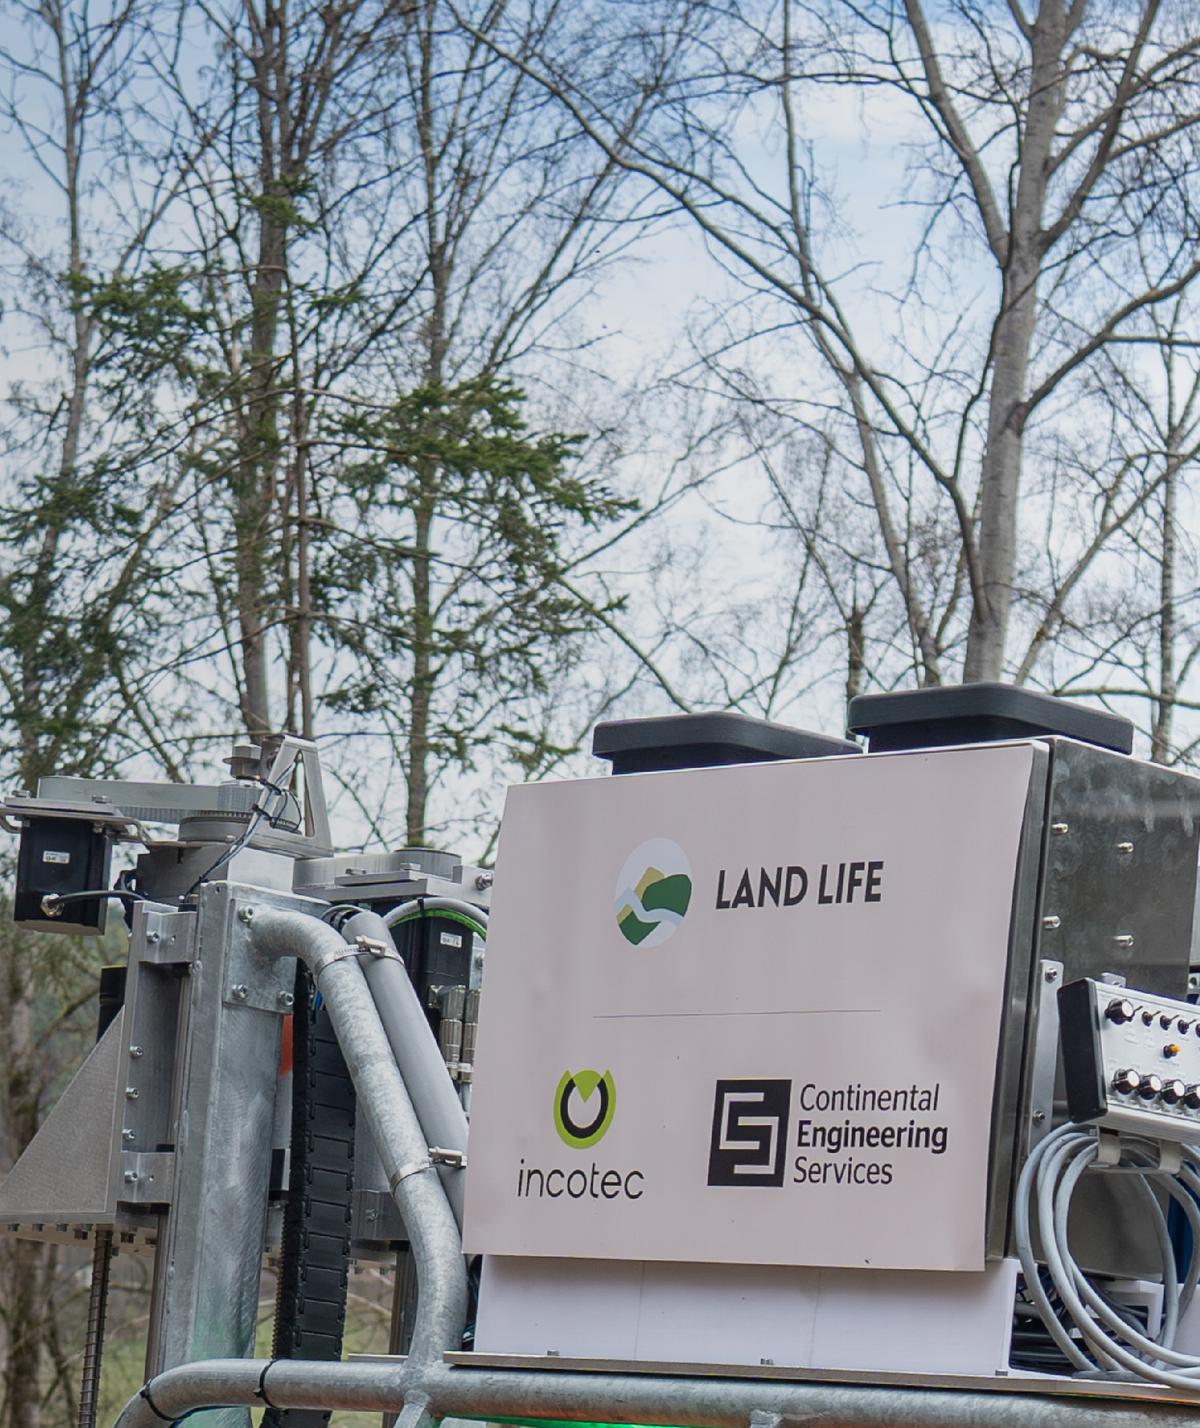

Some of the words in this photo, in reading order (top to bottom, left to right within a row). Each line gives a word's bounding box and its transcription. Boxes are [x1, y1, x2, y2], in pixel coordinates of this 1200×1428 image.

[715, 866, 808, 909] LAND
[818, 861, 884, 904] LIFE
[800, 1083, 940, 1111] Continental
[797, 1119, 948, 1154] Engineering
[517, 1158, 644, 1199] incotec
[793, 1156, 893, 1185] Services
